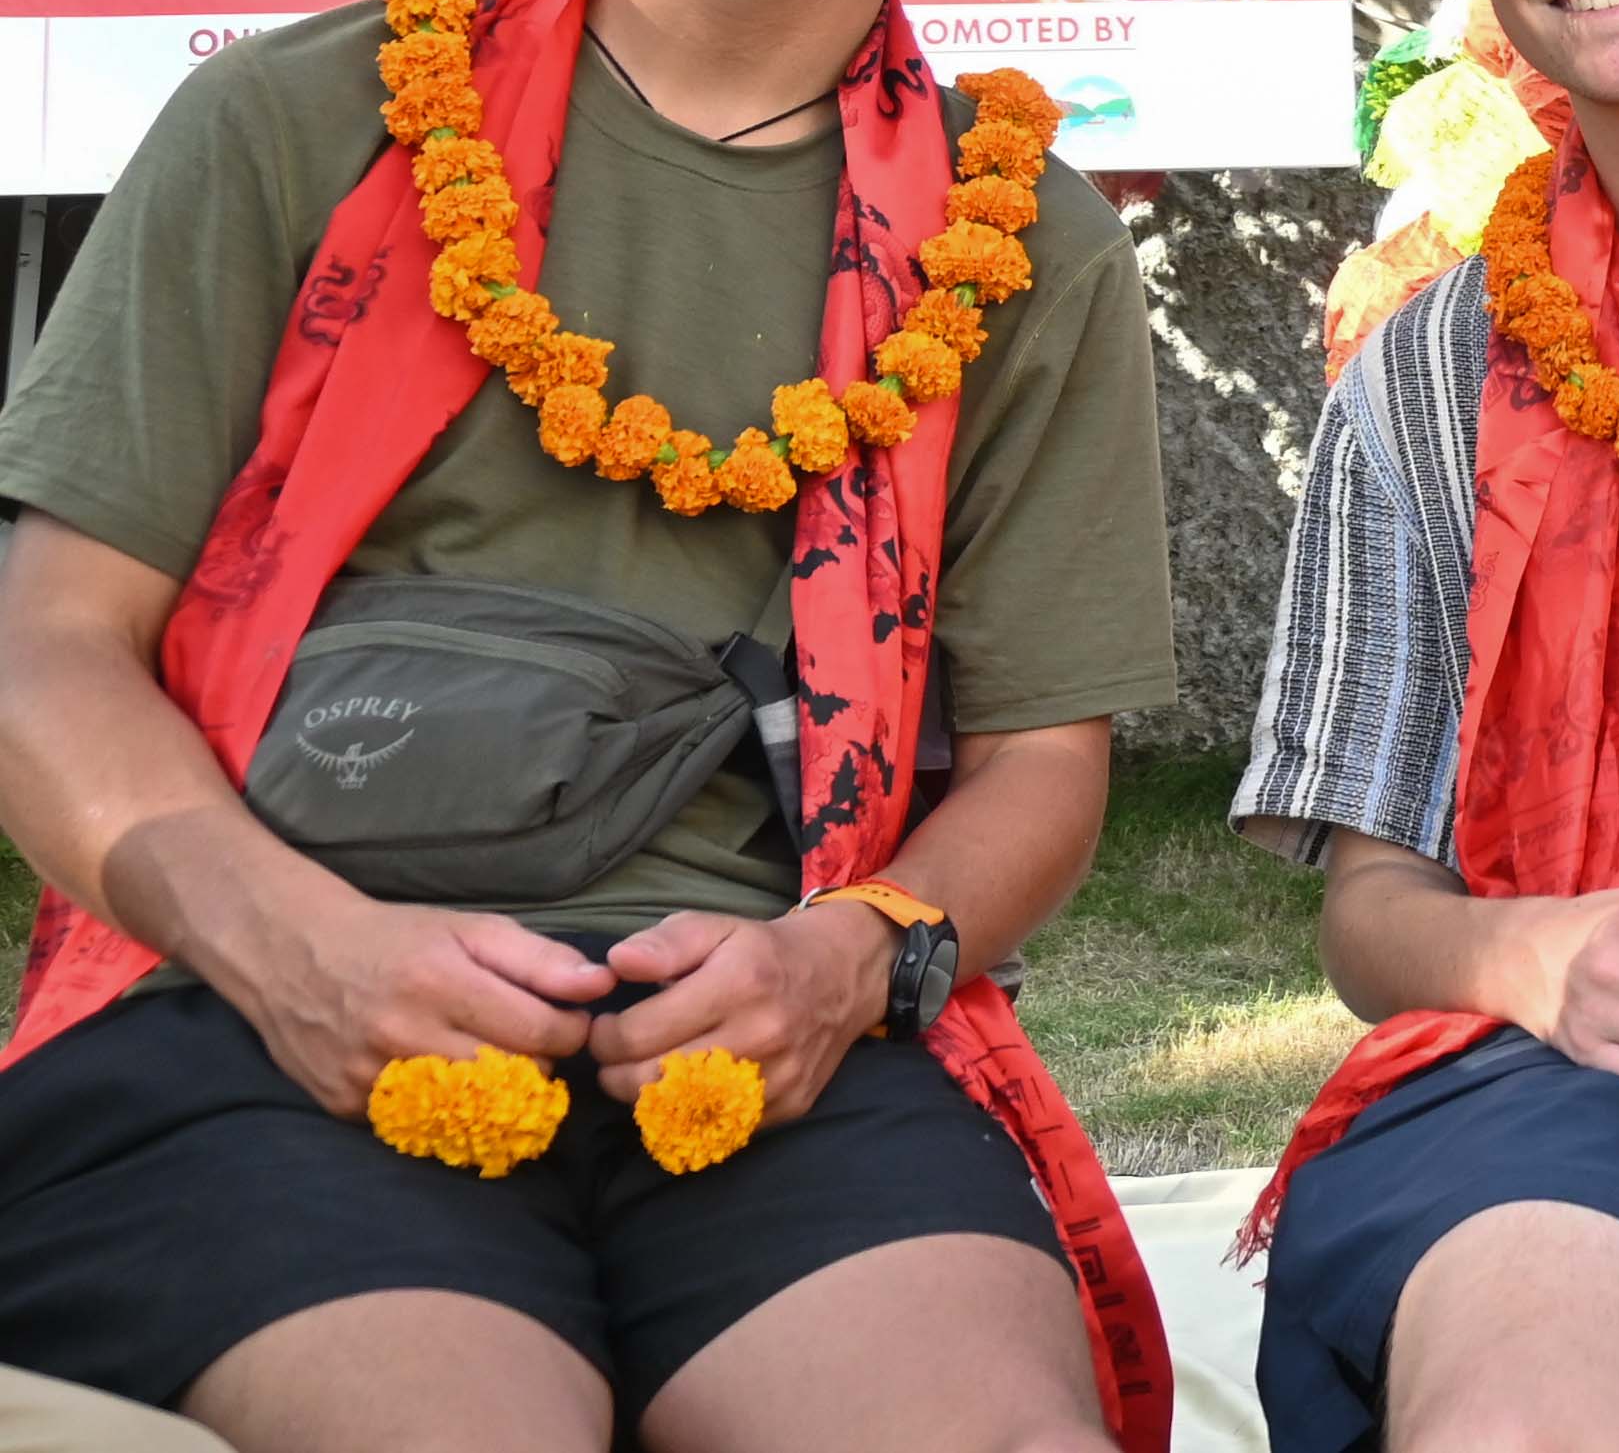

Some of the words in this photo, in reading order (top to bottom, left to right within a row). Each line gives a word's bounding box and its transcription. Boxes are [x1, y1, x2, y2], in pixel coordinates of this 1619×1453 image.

[912, 17, 1079, 45] OMOTED
[1095, 16, 1136, 43] BY
[303, 695, 422, 729] OSPREY
